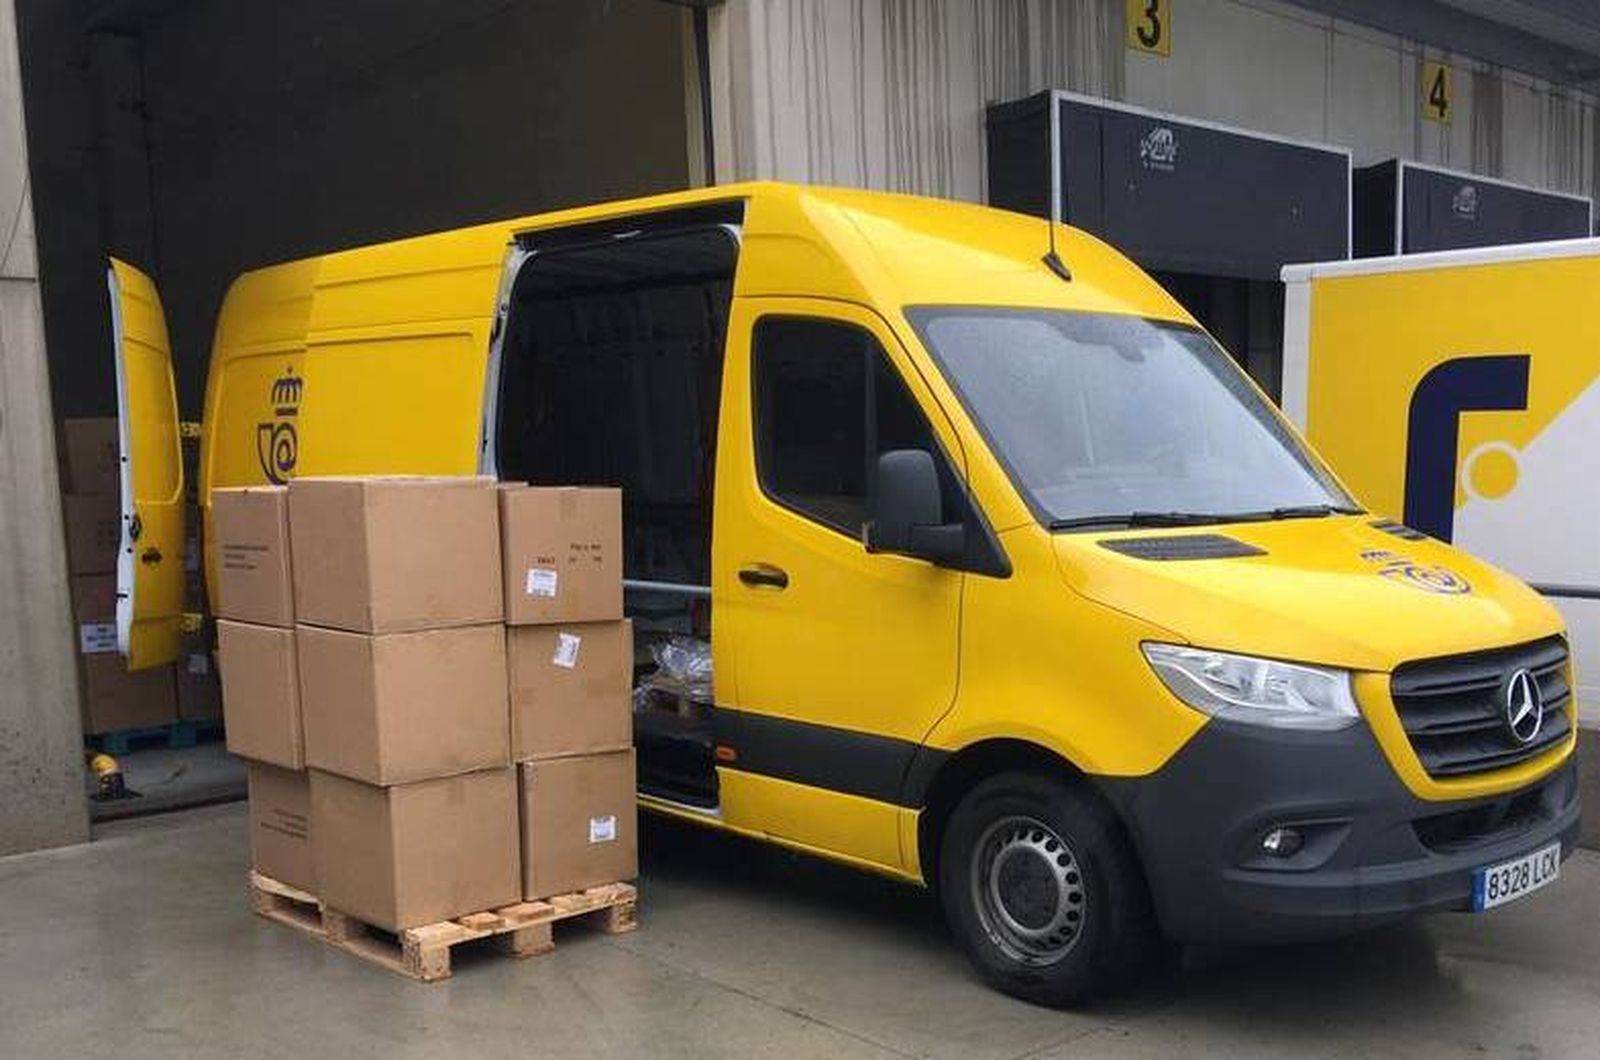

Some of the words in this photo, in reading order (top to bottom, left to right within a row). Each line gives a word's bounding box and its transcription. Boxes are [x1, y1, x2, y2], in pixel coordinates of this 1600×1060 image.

[1137, 0, 1160, 48] 3
[1430, 67, 1447, 117] 4
[1488, 861, 1530, 900] 8328
